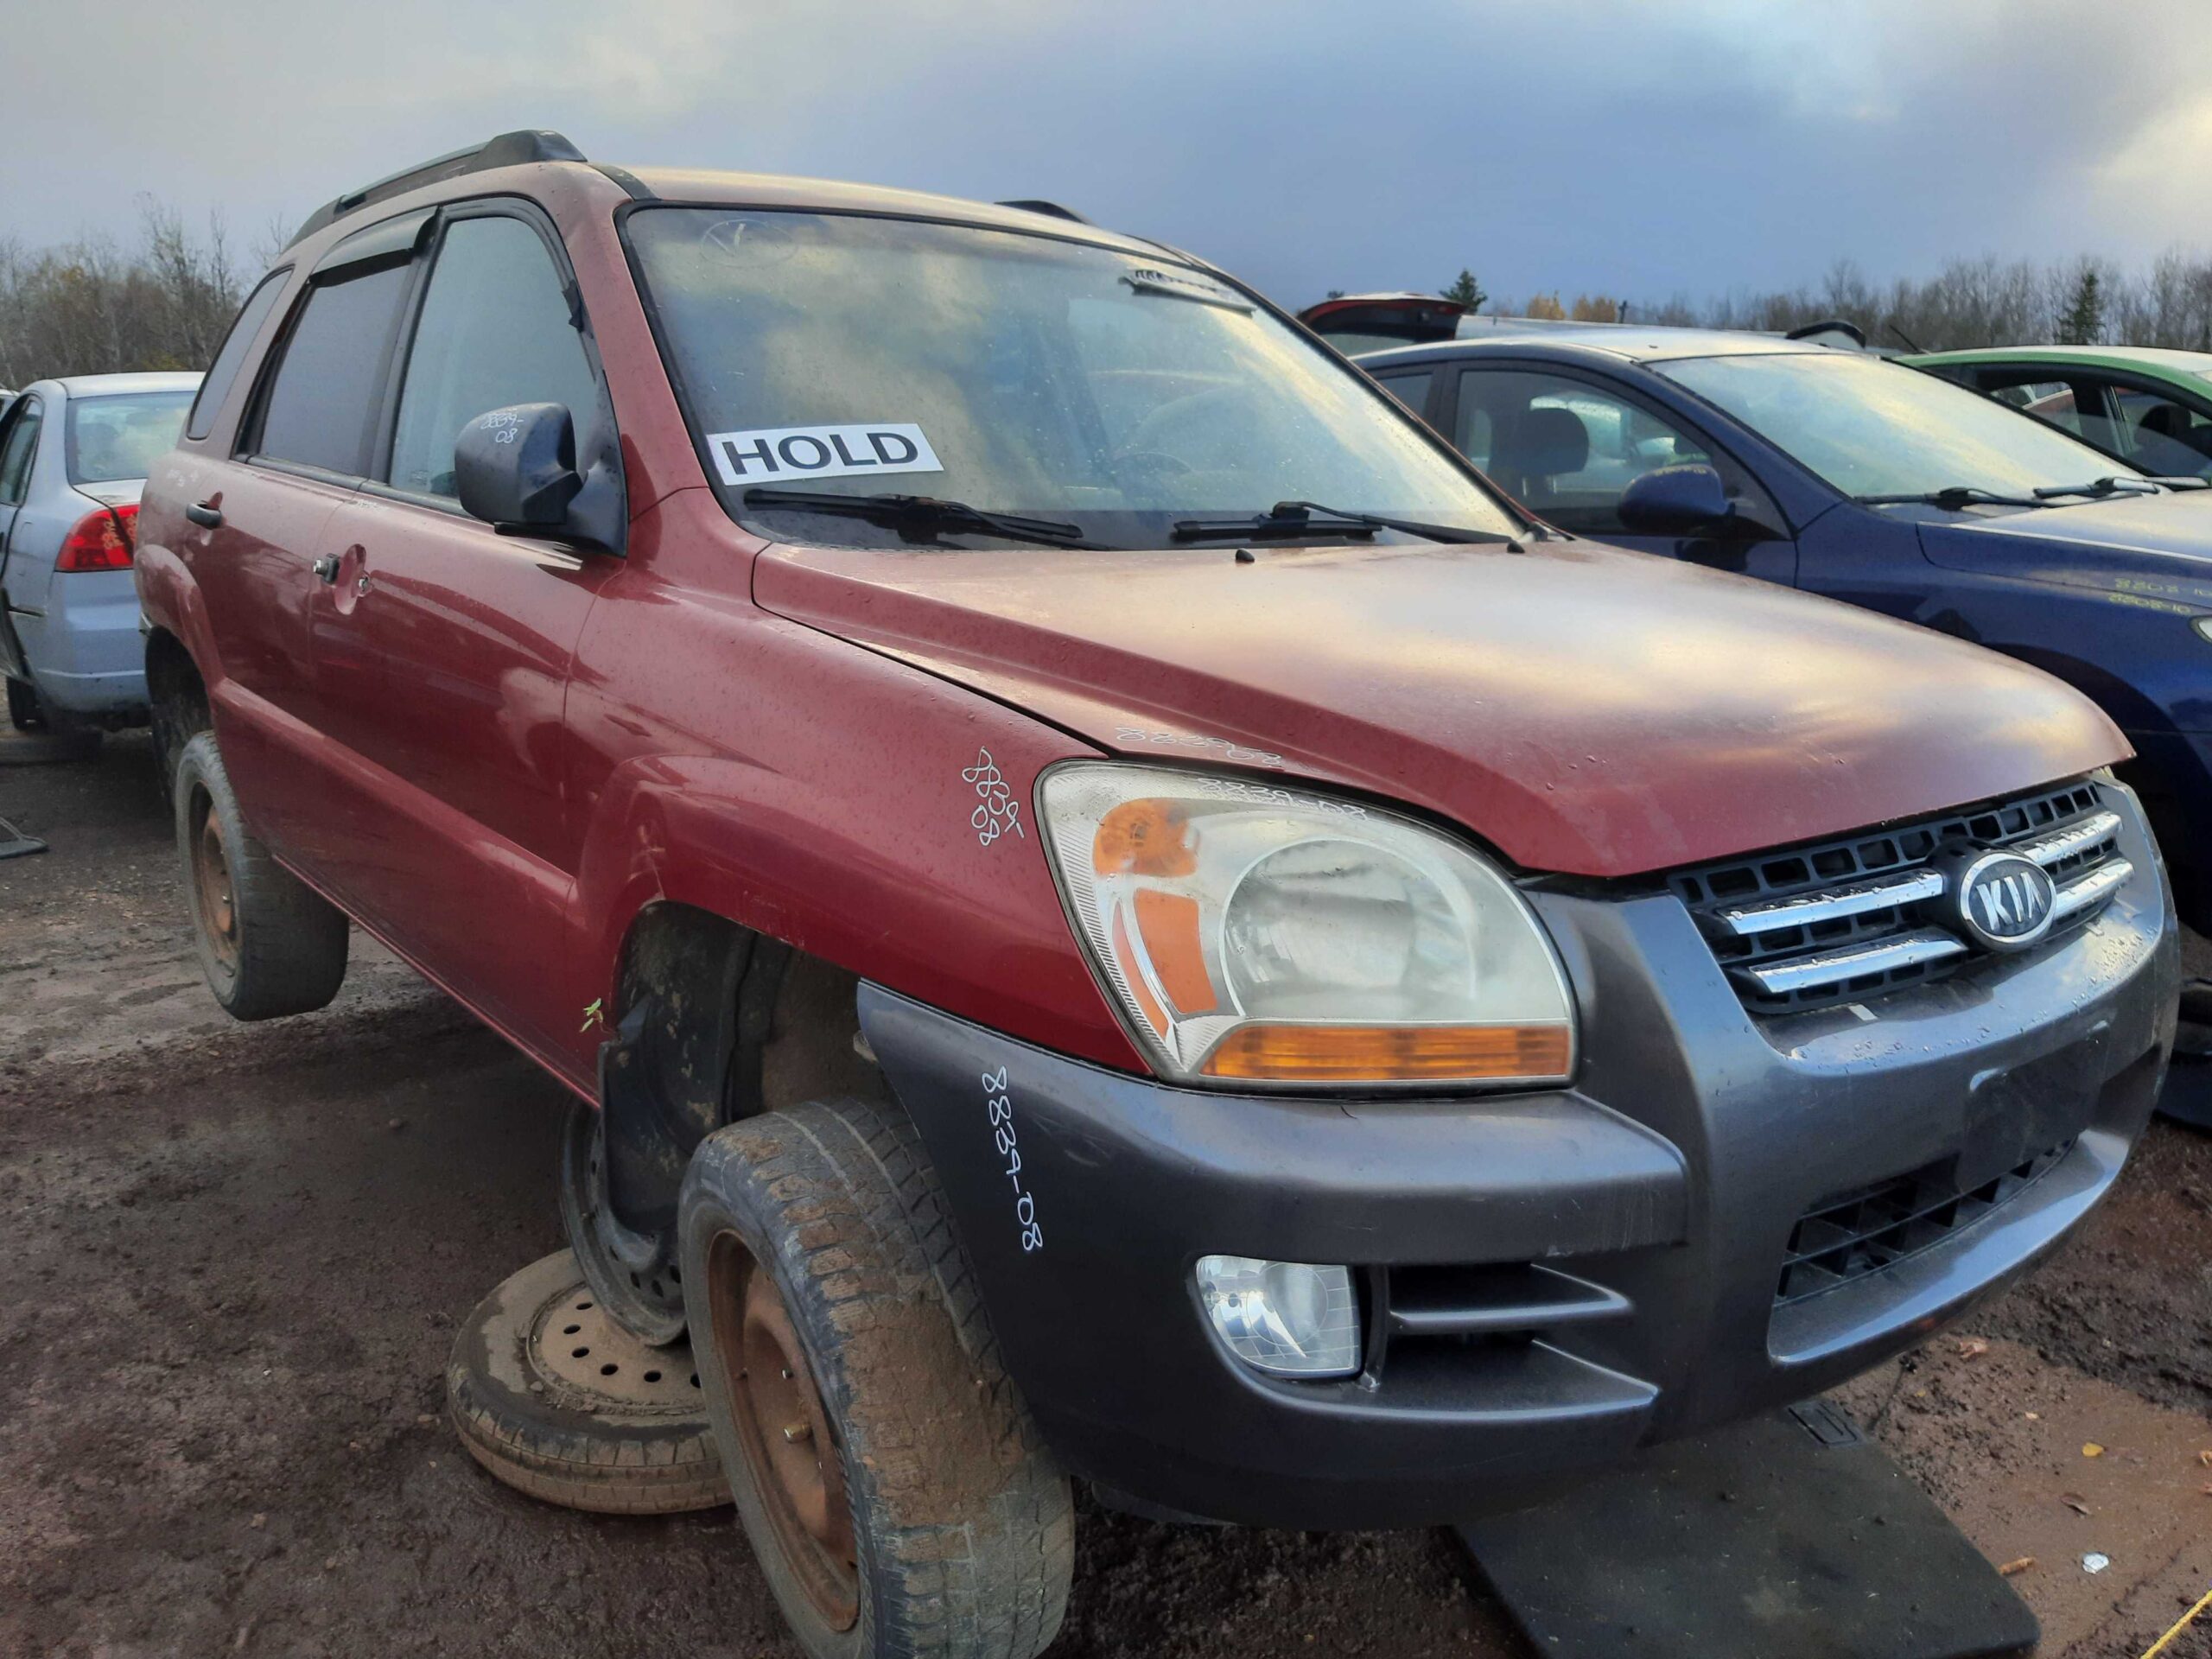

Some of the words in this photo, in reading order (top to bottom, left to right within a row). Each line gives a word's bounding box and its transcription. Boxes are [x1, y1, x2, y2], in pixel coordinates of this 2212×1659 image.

[496, 428, 518, 443] 08
[721, 432, 918, 475] HOLD
[1975, 871, 2047, 931] KIA
[982, 1065, 1044, 1251] 8839-08
